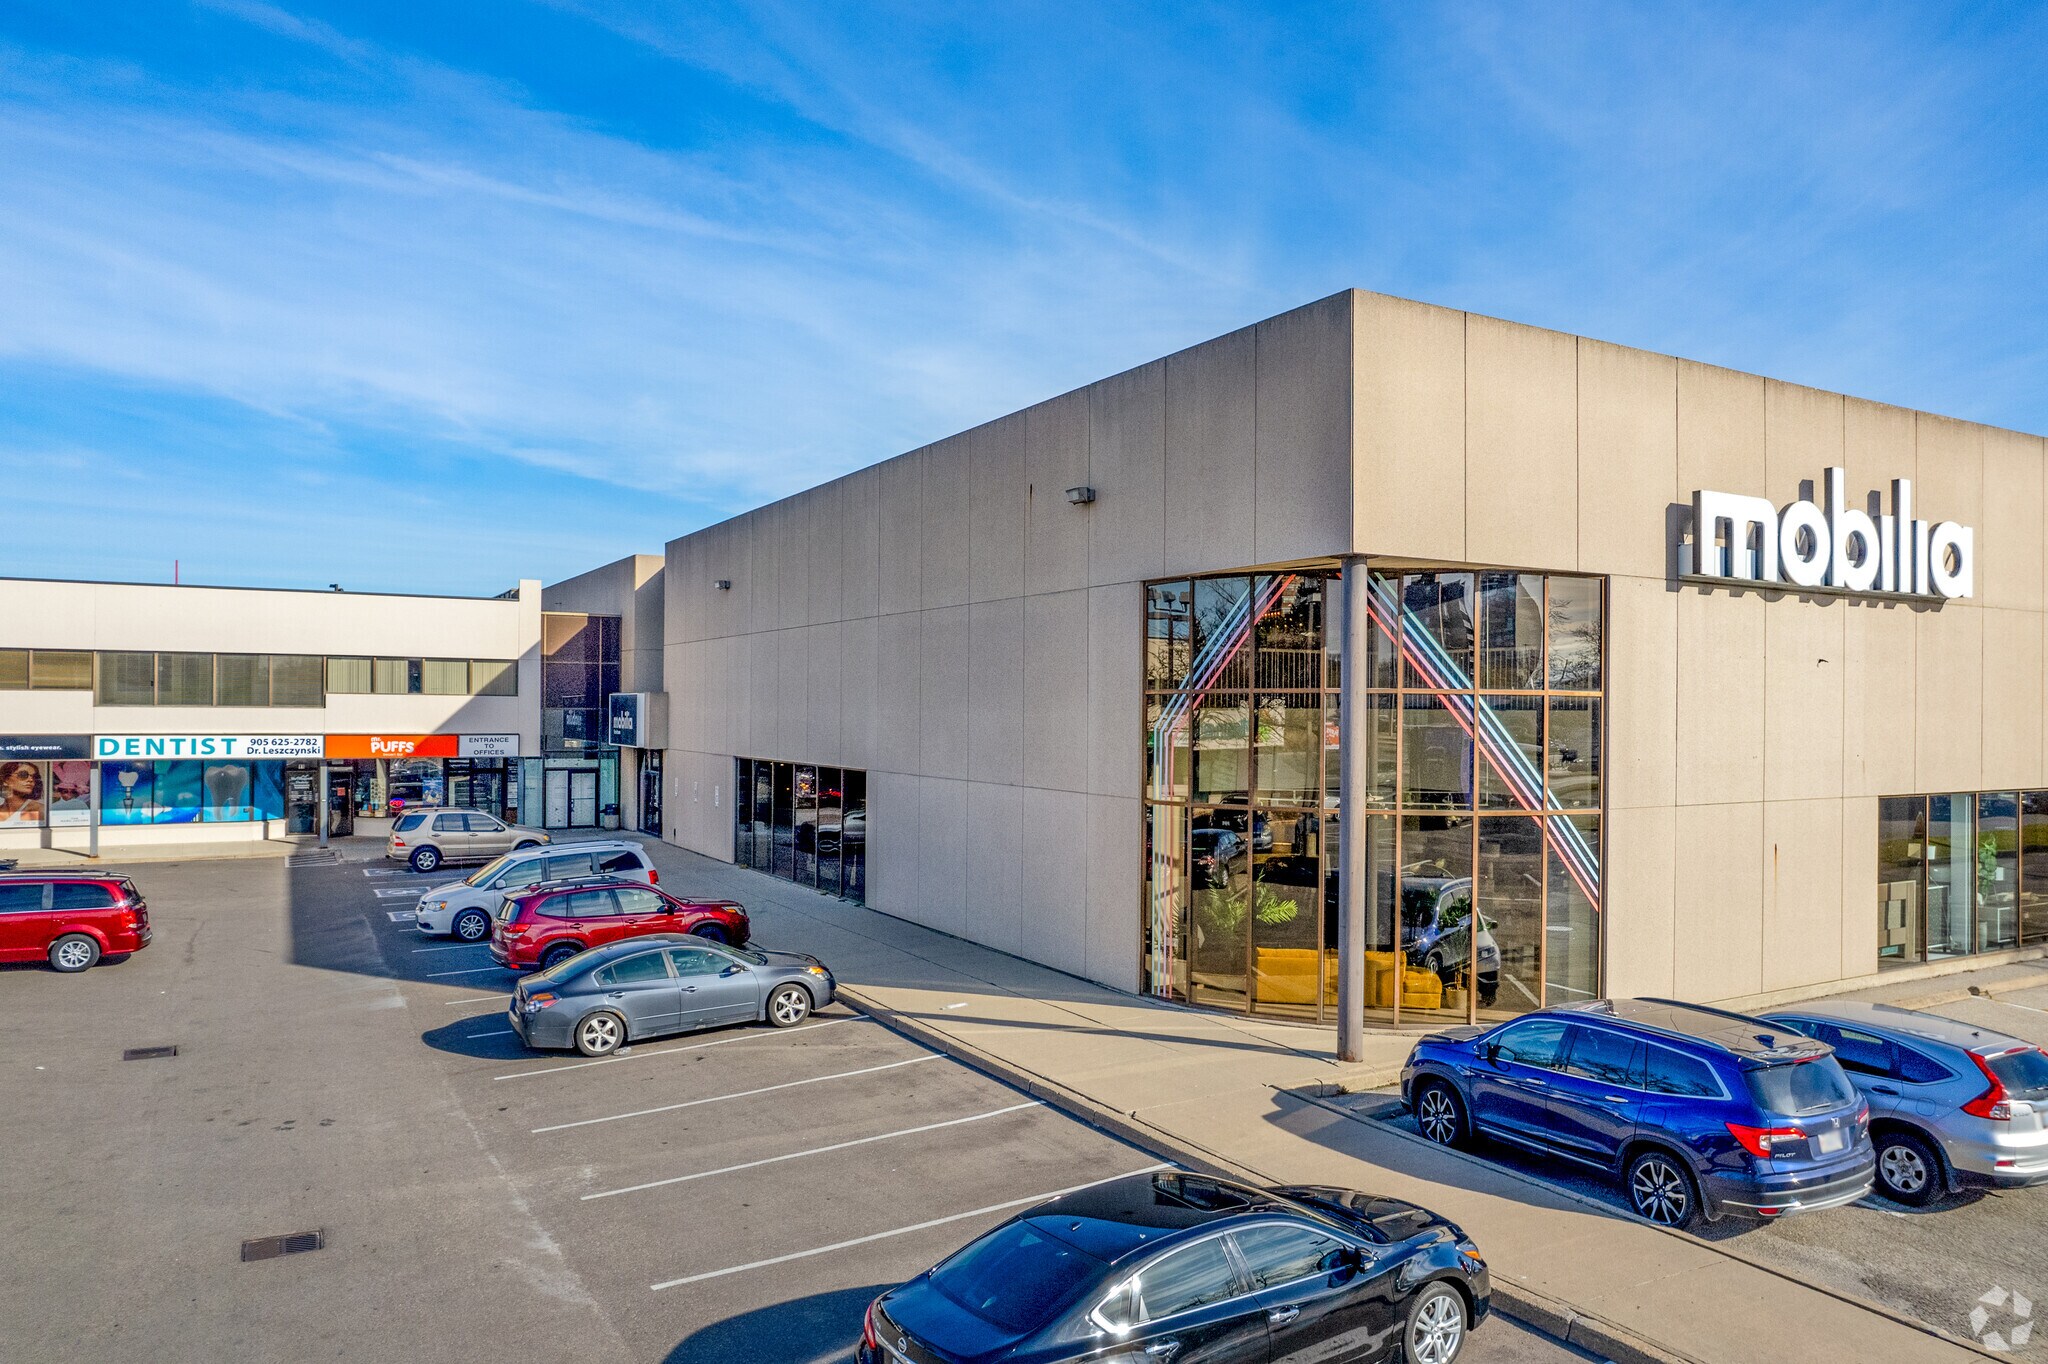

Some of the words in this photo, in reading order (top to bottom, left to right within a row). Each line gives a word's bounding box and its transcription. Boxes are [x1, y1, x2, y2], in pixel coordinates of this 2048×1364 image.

[1693, 467, 1973, 598] mobilia
[613, 710, 633, 730] mobilia
[99, 738, 237, 755] DENTIST
[250, 738, 269, 746] 905
[271, 738, 317, 746] 625-2782
[371, 740, 414, 753] PUFFS
[263, 746, 320, 756] Leszczynski
